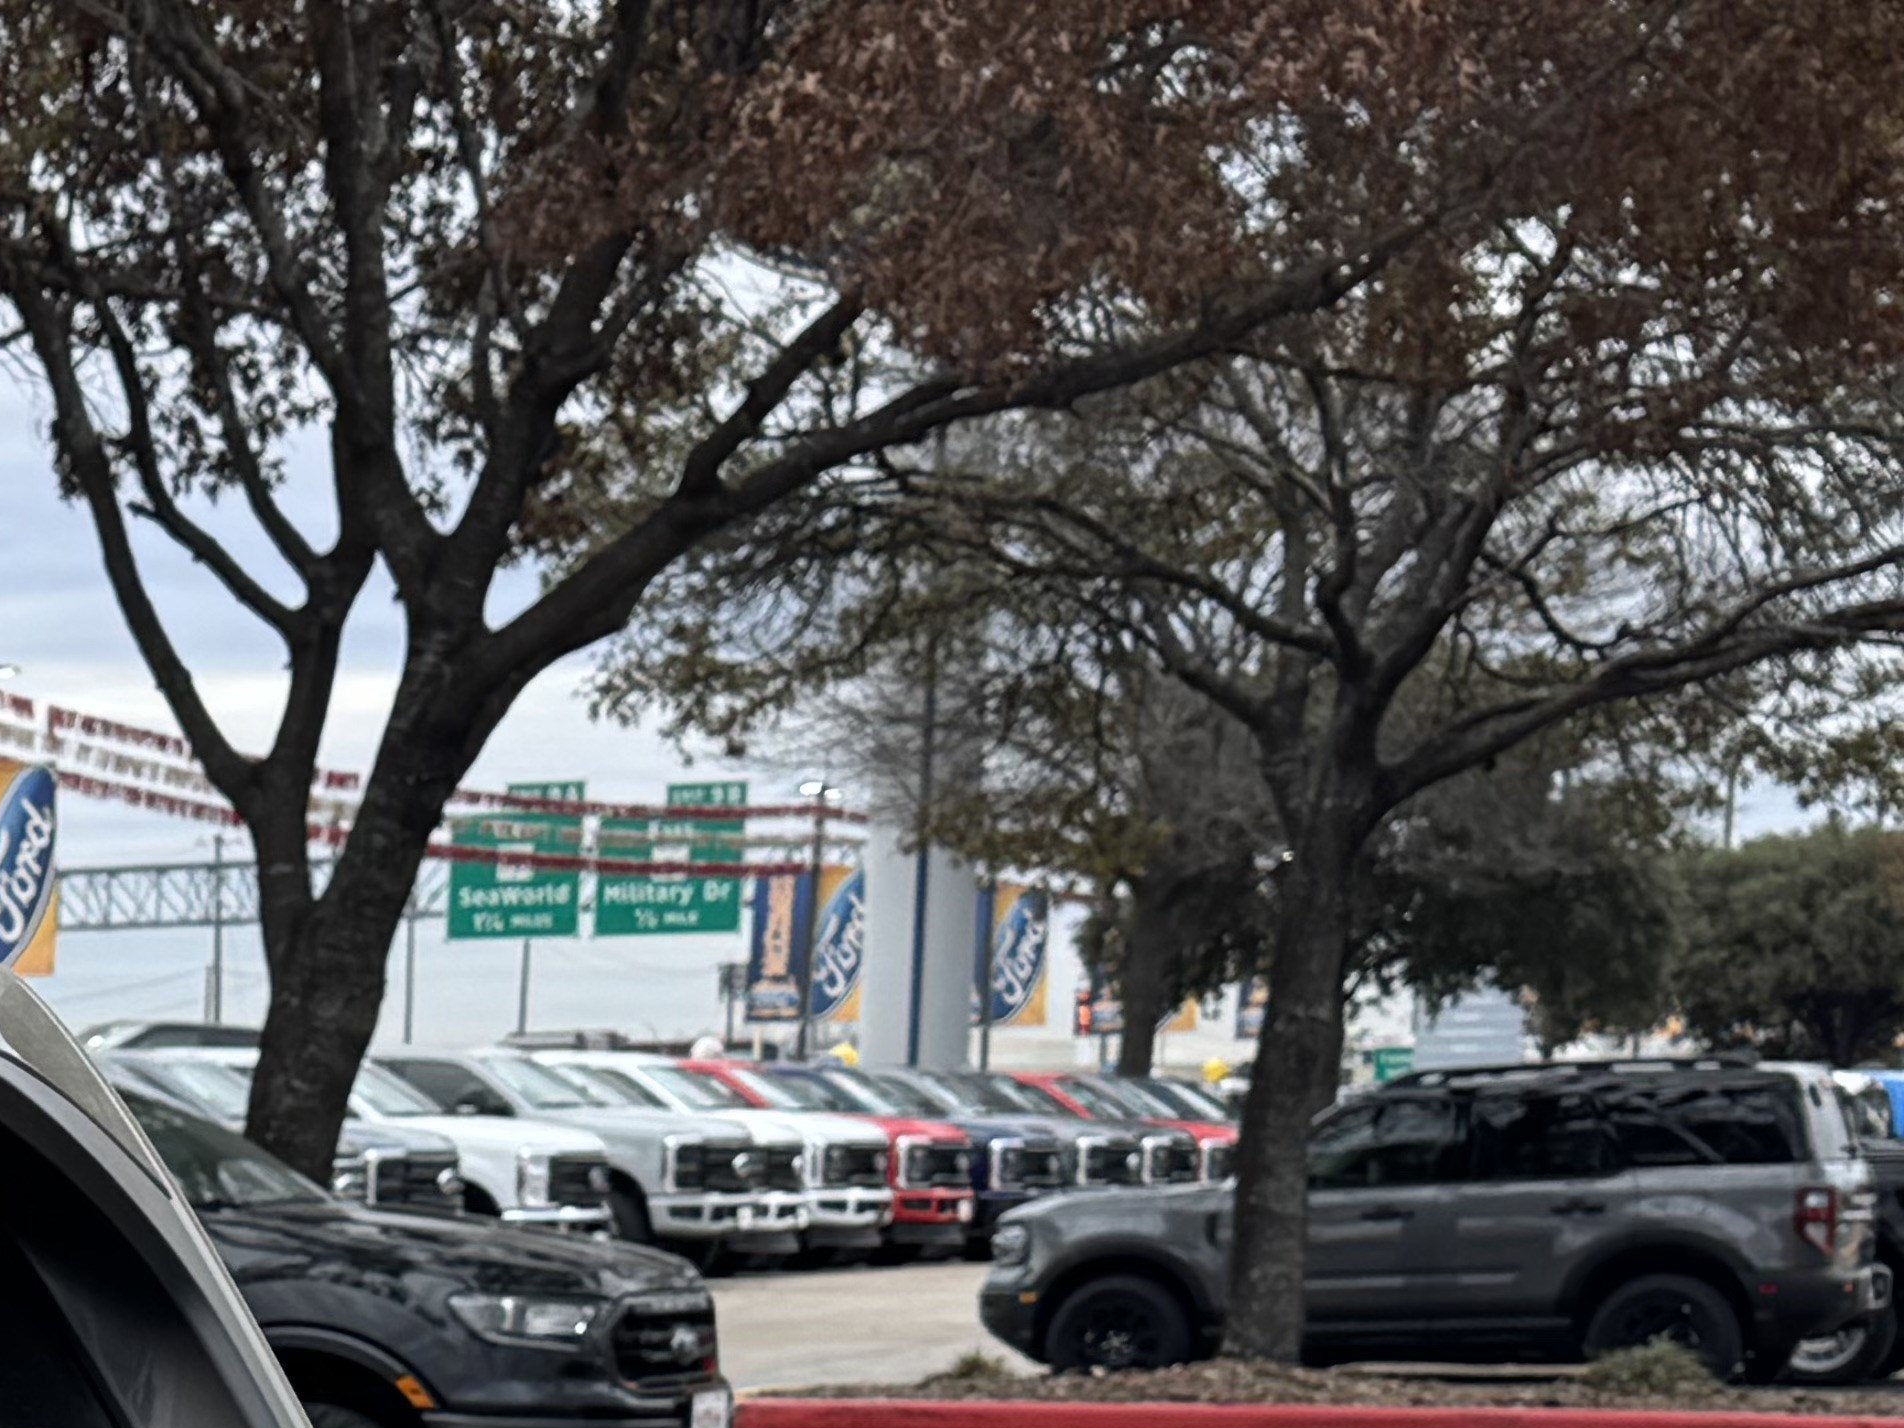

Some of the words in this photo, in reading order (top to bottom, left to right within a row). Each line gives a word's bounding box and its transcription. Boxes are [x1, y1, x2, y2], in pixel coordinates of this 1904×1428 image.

[458, 882, 571, 909] SeaWorld
[603, 880, 696, 908] Military
[703, 879, 732, 903] Dr
